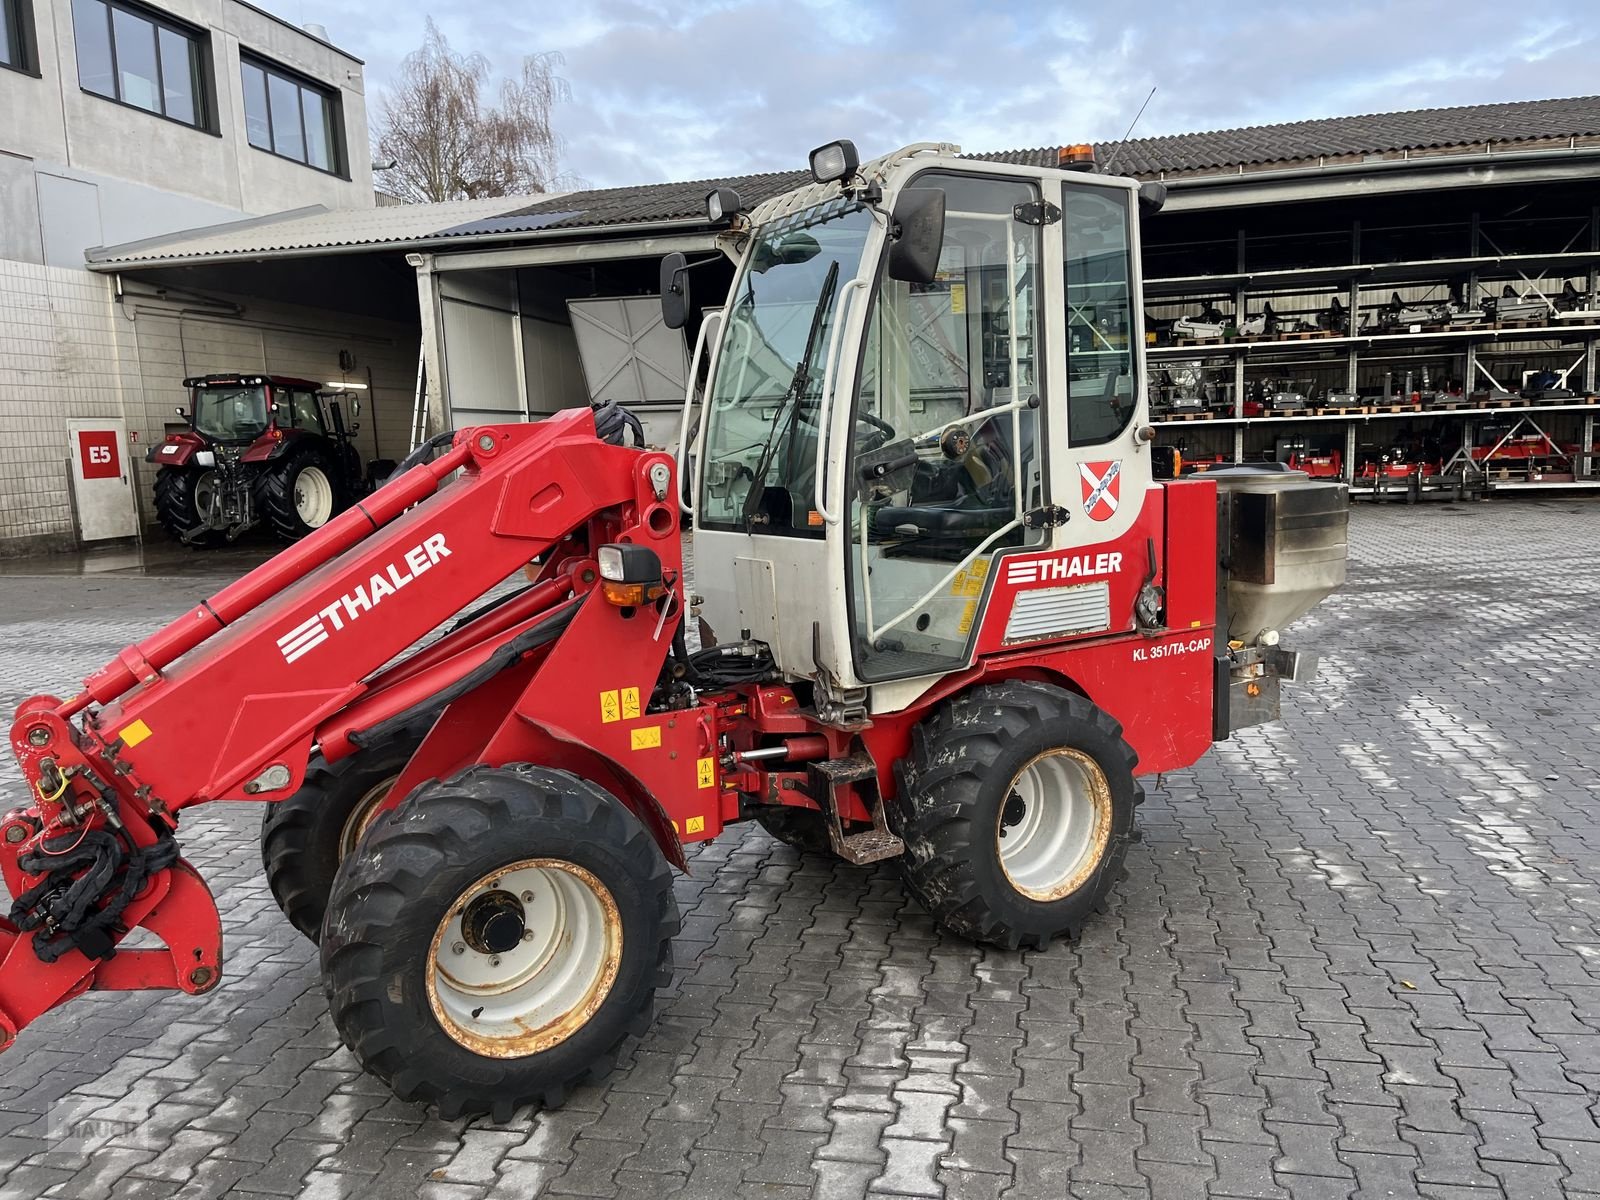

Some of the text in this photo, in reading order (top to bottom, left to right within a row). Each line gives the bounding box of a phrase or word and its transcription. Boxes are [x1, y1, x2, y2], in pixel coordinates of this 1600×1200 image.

[89, 446, 111, 464] E5
[1037, 552, 1123, 581] THALER
[318, 533, 453, 631] THALER
[1133, 638, 1211, 662] KL 351/TA-CAP
